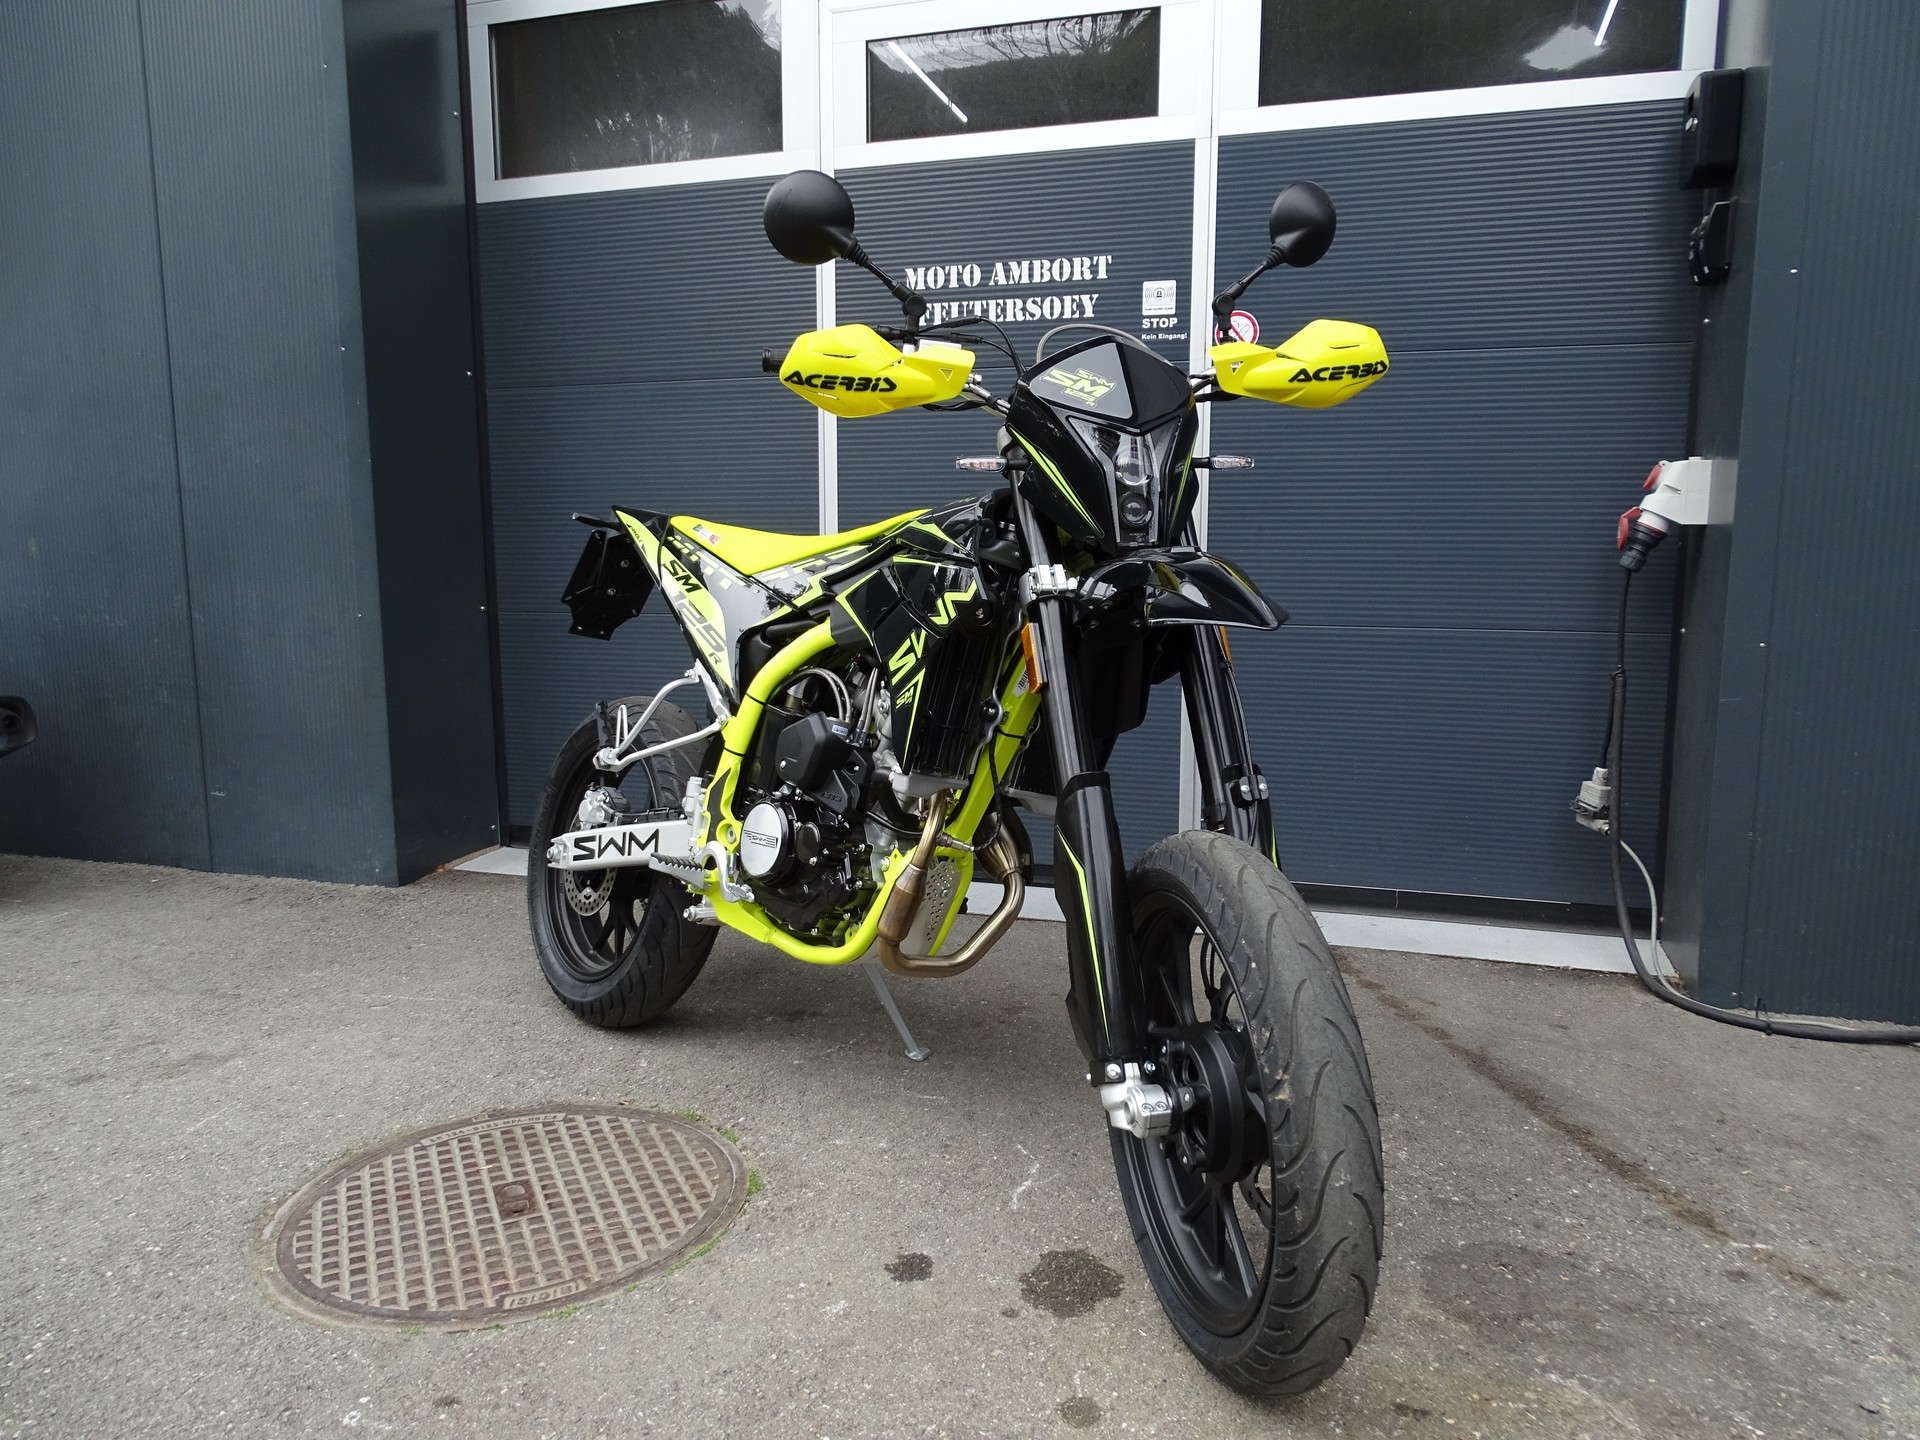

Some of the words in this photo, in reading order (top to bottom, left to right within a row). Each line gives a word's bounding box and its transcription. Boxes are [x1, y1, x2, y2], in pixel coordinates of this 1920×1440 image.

[905, 264, 982, 290] MOTO
[989, 255, 1112, 286] AMBORT
[1141, 317, 1178, 329] STOP
[1158, 332, 1188, 340] Eingang!
[784, 370, 898, 393] ACERBIS
[1043, 368, 1111, 398] SM
[1077, 369, 1115, 389] SWM
[1288, 360, 1388, 383] ACERBIS
[662, 559, 703, 593] SM
[672, 591, 727, 653] 125
[573, 828, 660, 862] SWM
